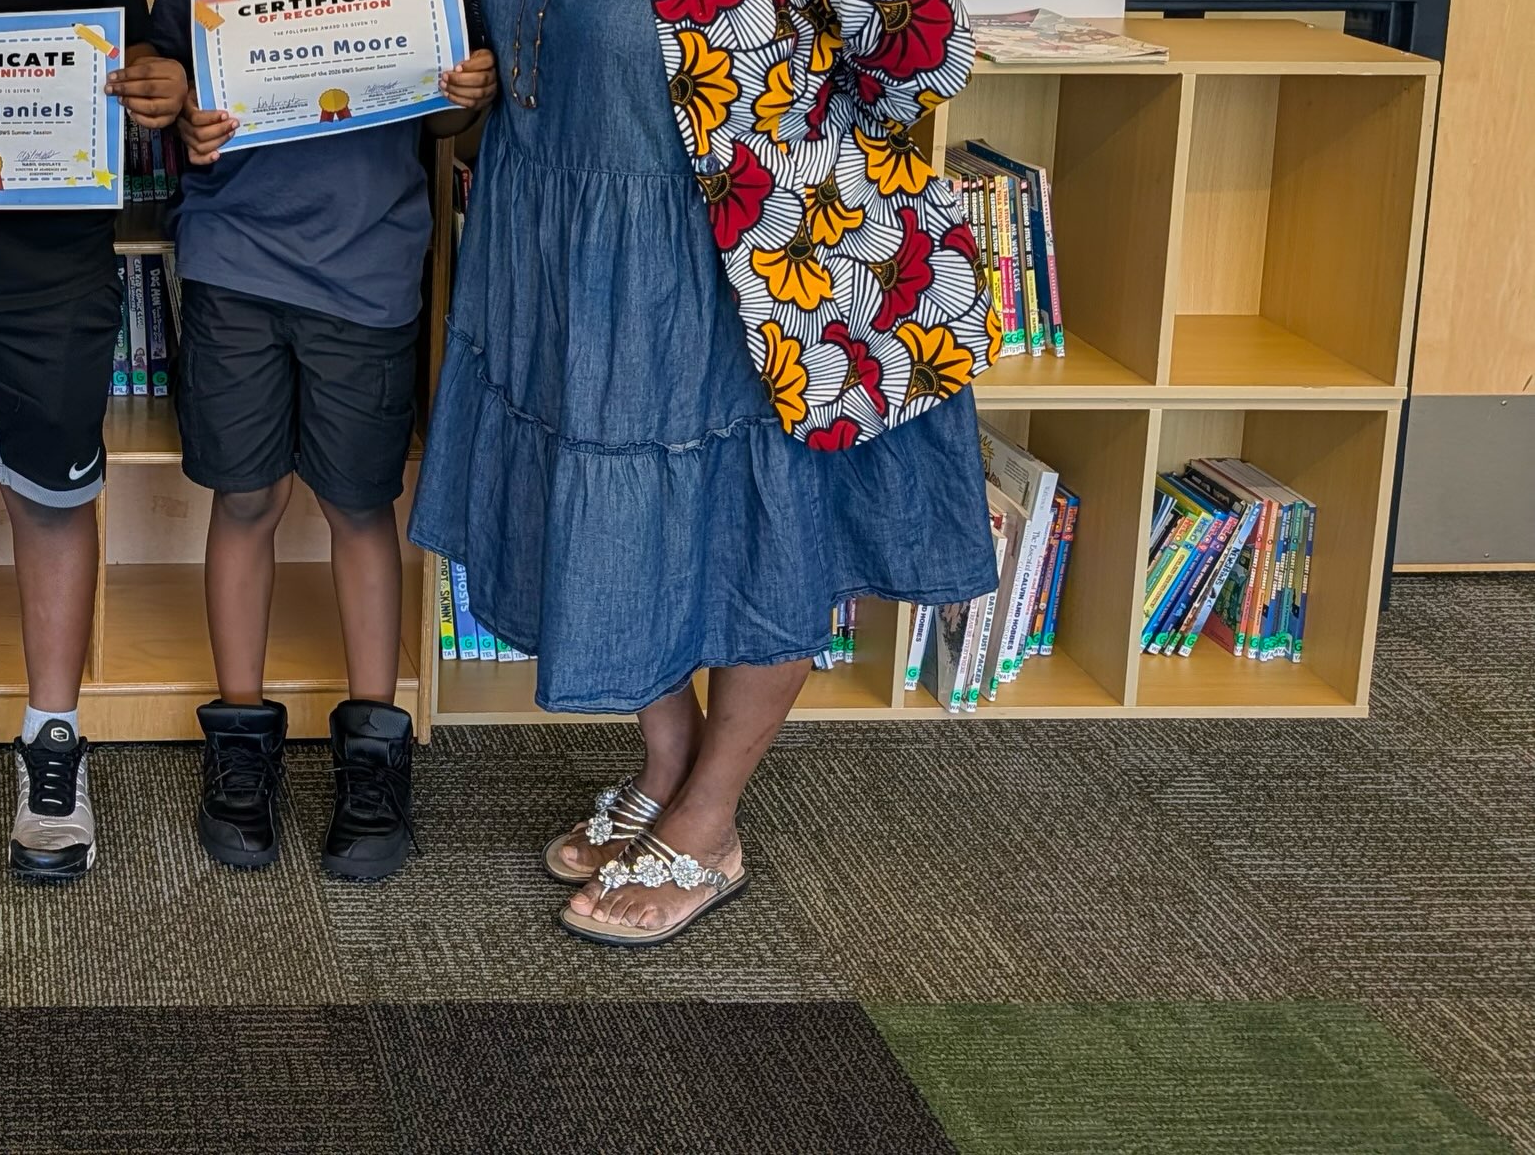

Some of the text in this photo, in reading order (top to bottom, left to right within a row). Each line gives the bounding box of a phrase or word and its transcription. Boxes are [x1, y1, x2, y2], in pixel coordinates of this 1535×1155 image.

[258, 0, 391, 24] OF RECOGNITION
[249, 35, 408, 65] Mason Moore
[456, 564, 469, 613] GHOSTS
[440, 590, 452, 624] SKINNY
[987, 596, 995, 614] DAYS
[1007, 572, 1029, 650] CALVIN AND HOBBES
[975, 653, 985, 683] PACKED
